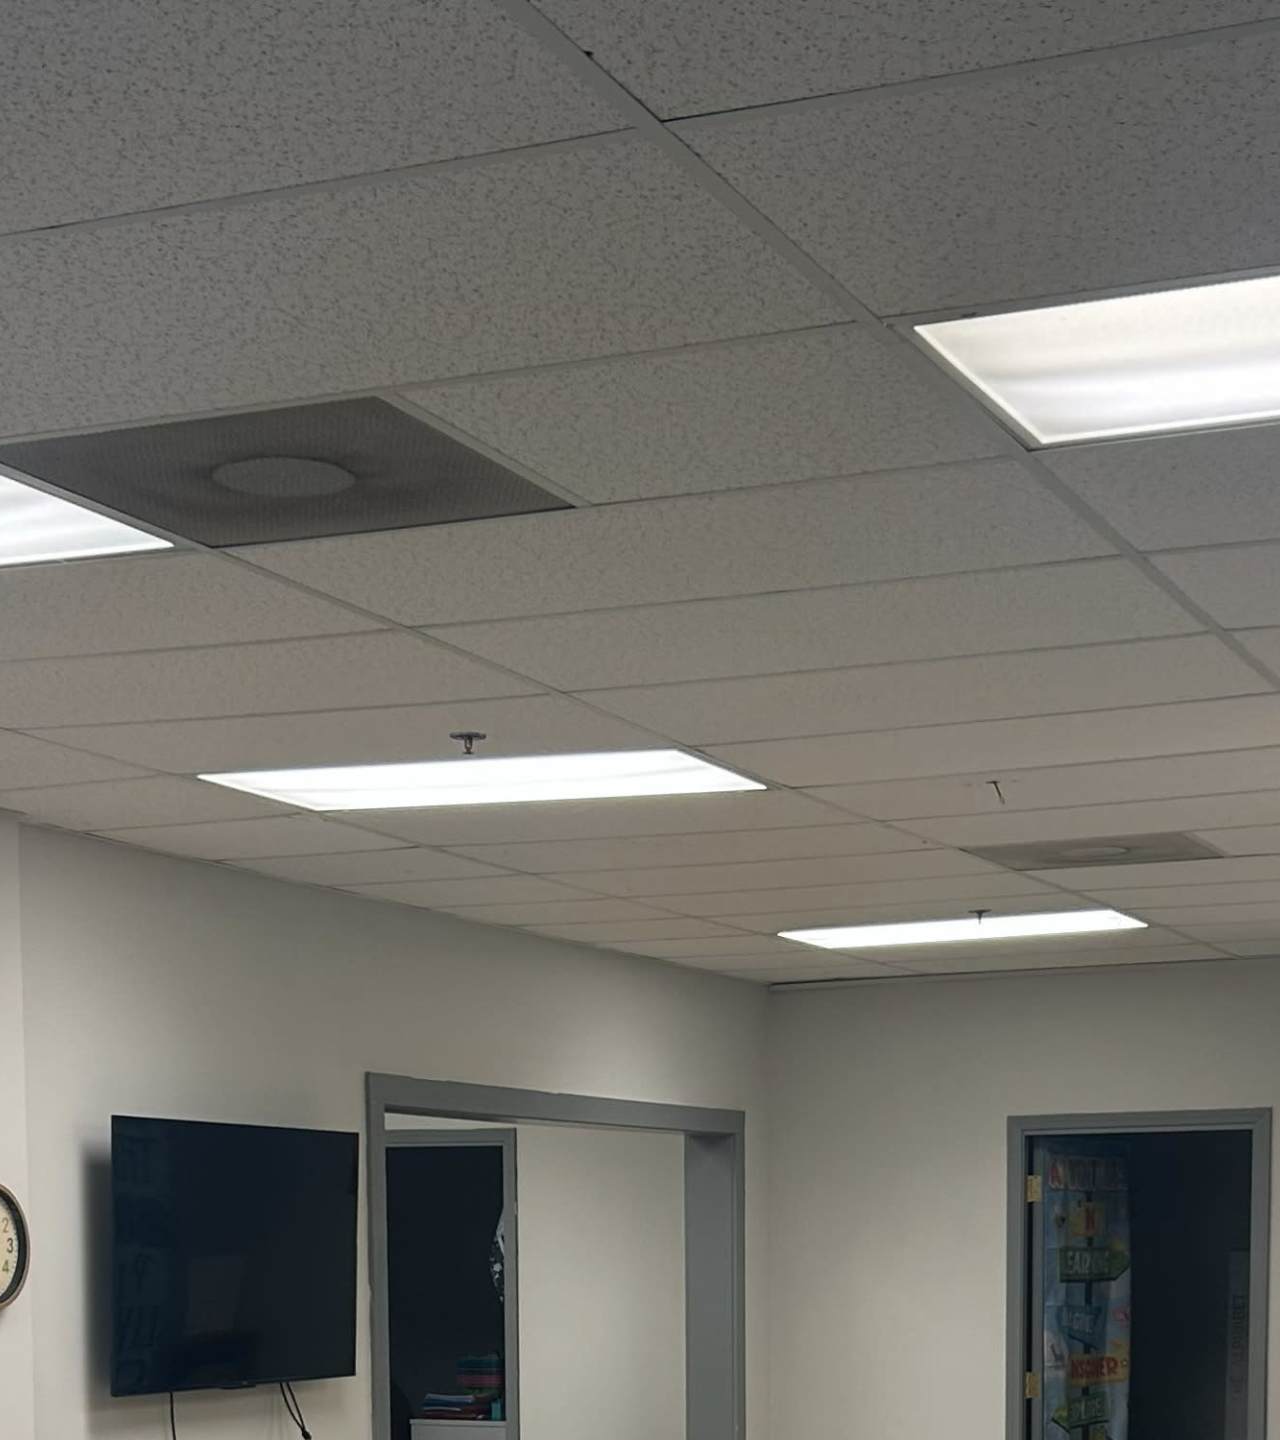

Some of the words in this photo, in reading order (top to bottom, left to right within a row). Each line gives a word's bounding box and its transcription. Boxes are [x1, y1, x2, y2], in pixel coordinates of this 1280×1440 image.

[1, 1218, 9, 1233] 2
[6, 1237, 14, 1253] 3
[1, 1259, 9, 1273] 4
